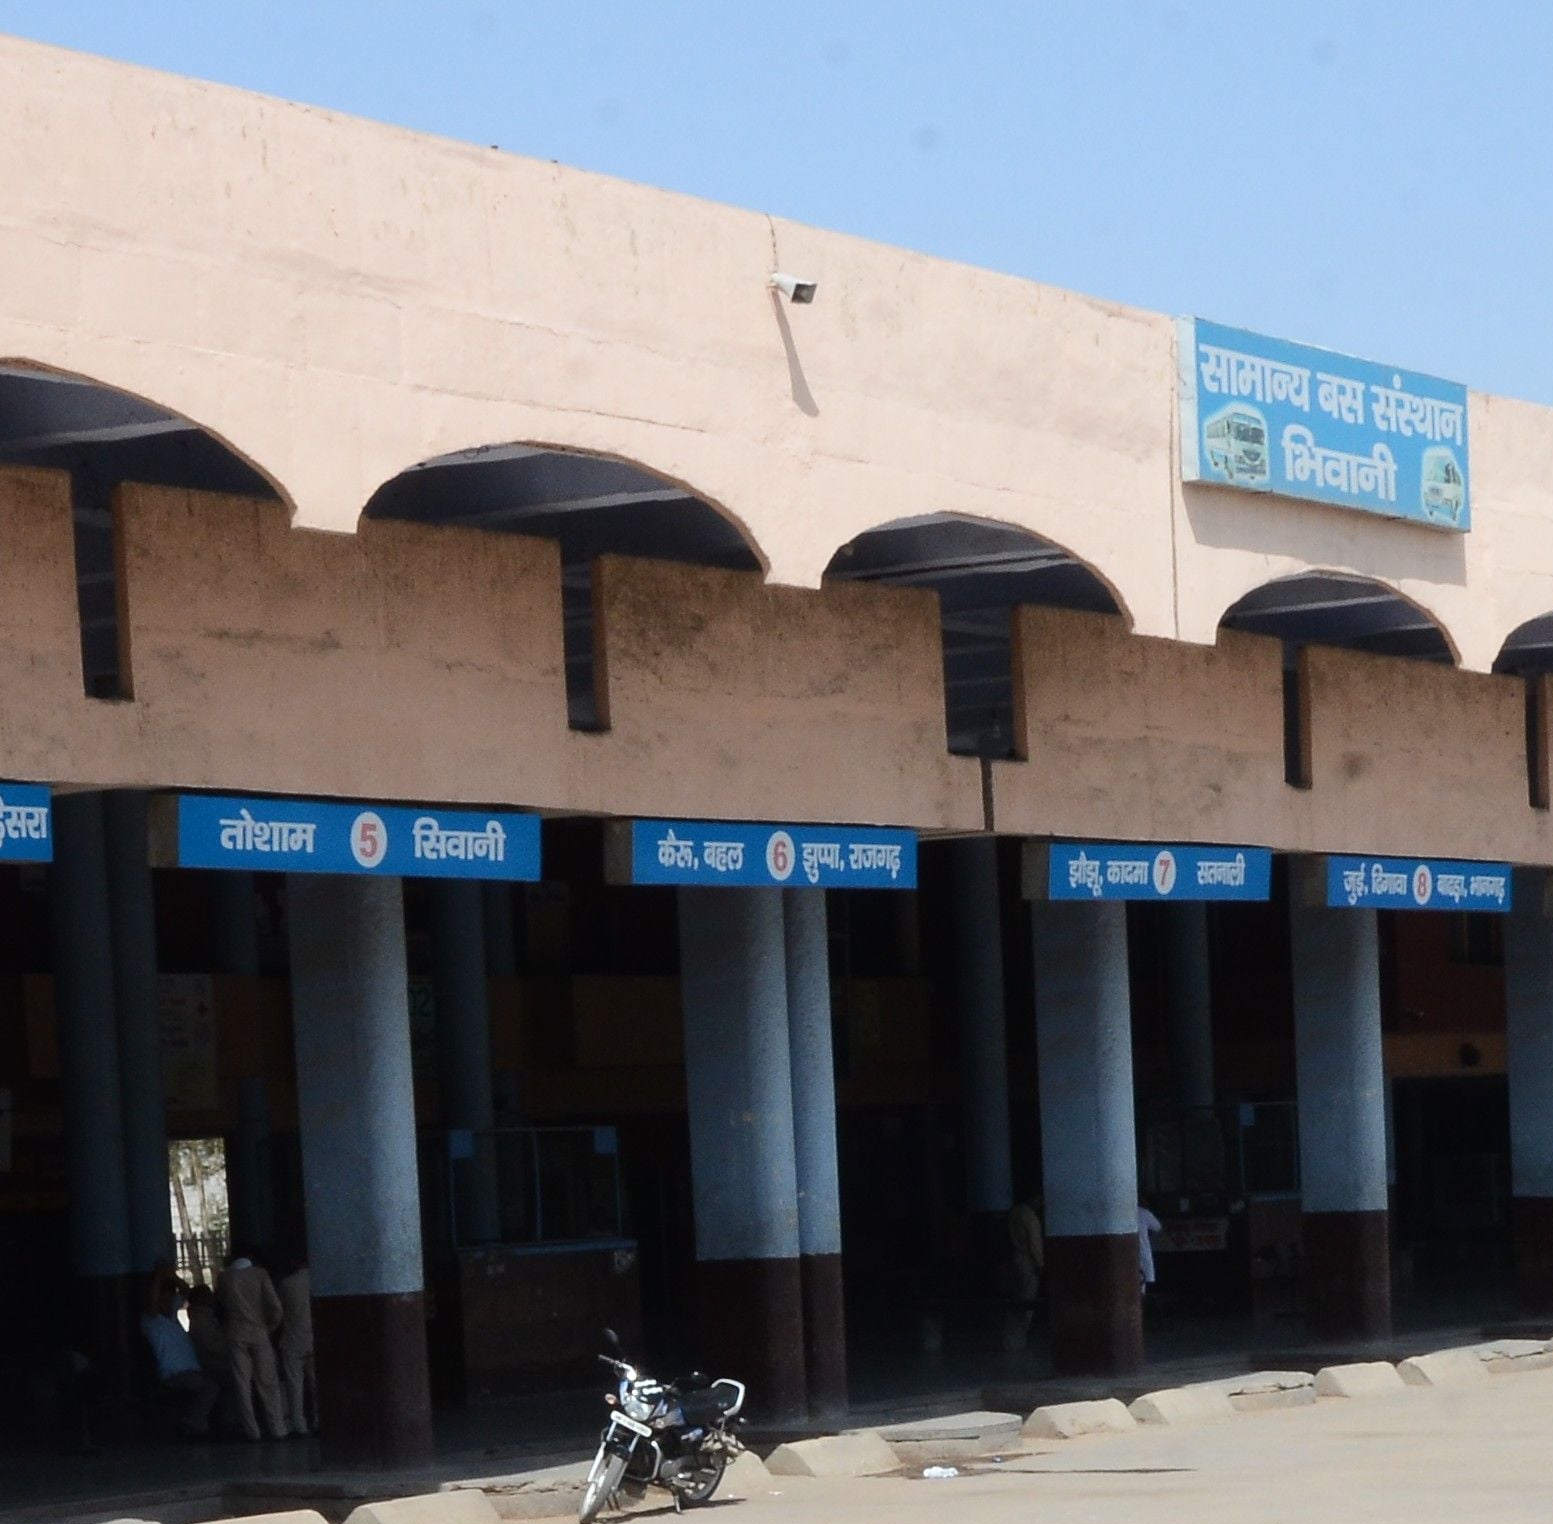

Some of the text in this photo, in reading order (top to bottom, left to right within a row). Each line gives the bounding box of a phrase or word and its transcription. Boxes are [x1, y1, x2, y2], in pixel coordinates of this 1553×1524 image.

[1199, 344, 1463, 445] सामान्य बस संस्थान
[1282, 424, 1396, 501] भिवानी
[219, 808, 506, 862] तोशाम 5 सिवानी
[703, 841, 744, 872] बहल
[773, 841, 788, 871] 6
[849, 844, 901, 880] राजगढ़
[1159, 860, 1170, 886] 7
